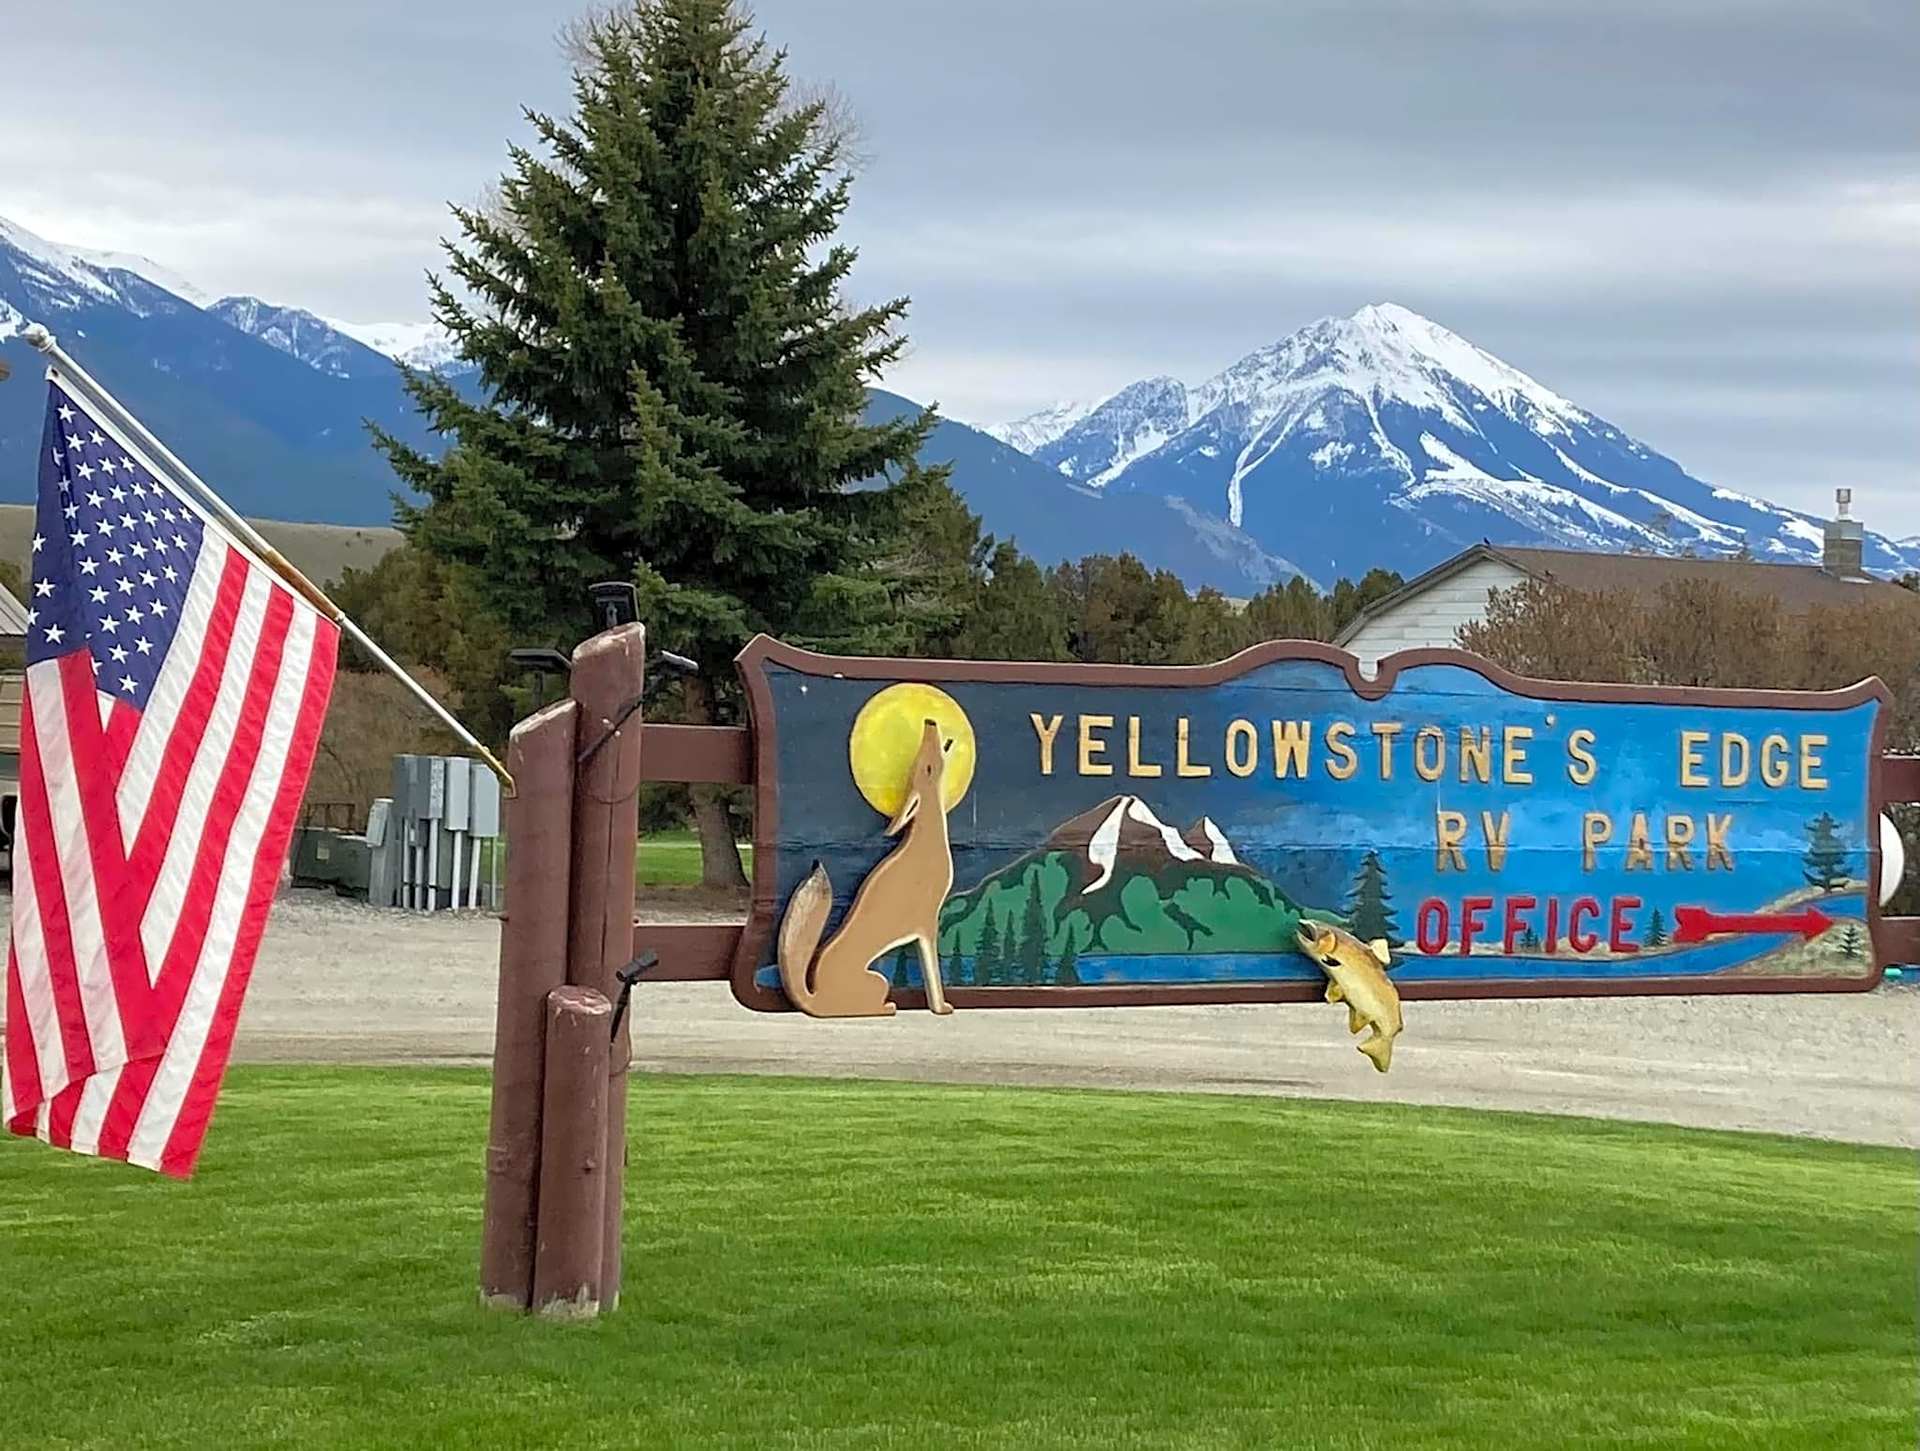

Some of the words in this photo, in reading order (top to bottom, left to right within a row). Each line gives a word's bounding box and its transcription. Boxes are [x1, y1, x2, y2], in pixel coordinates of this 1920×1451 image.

[1030, 713, 1597, 785] YELLOWSTONE'S
[1681, 731, 1828, 789] EDGE
[1436, 810, 1510, 871] RV
[1584, 812, 1735, 872] PARK
[1417, 897, 1642, 956] OFFICE
